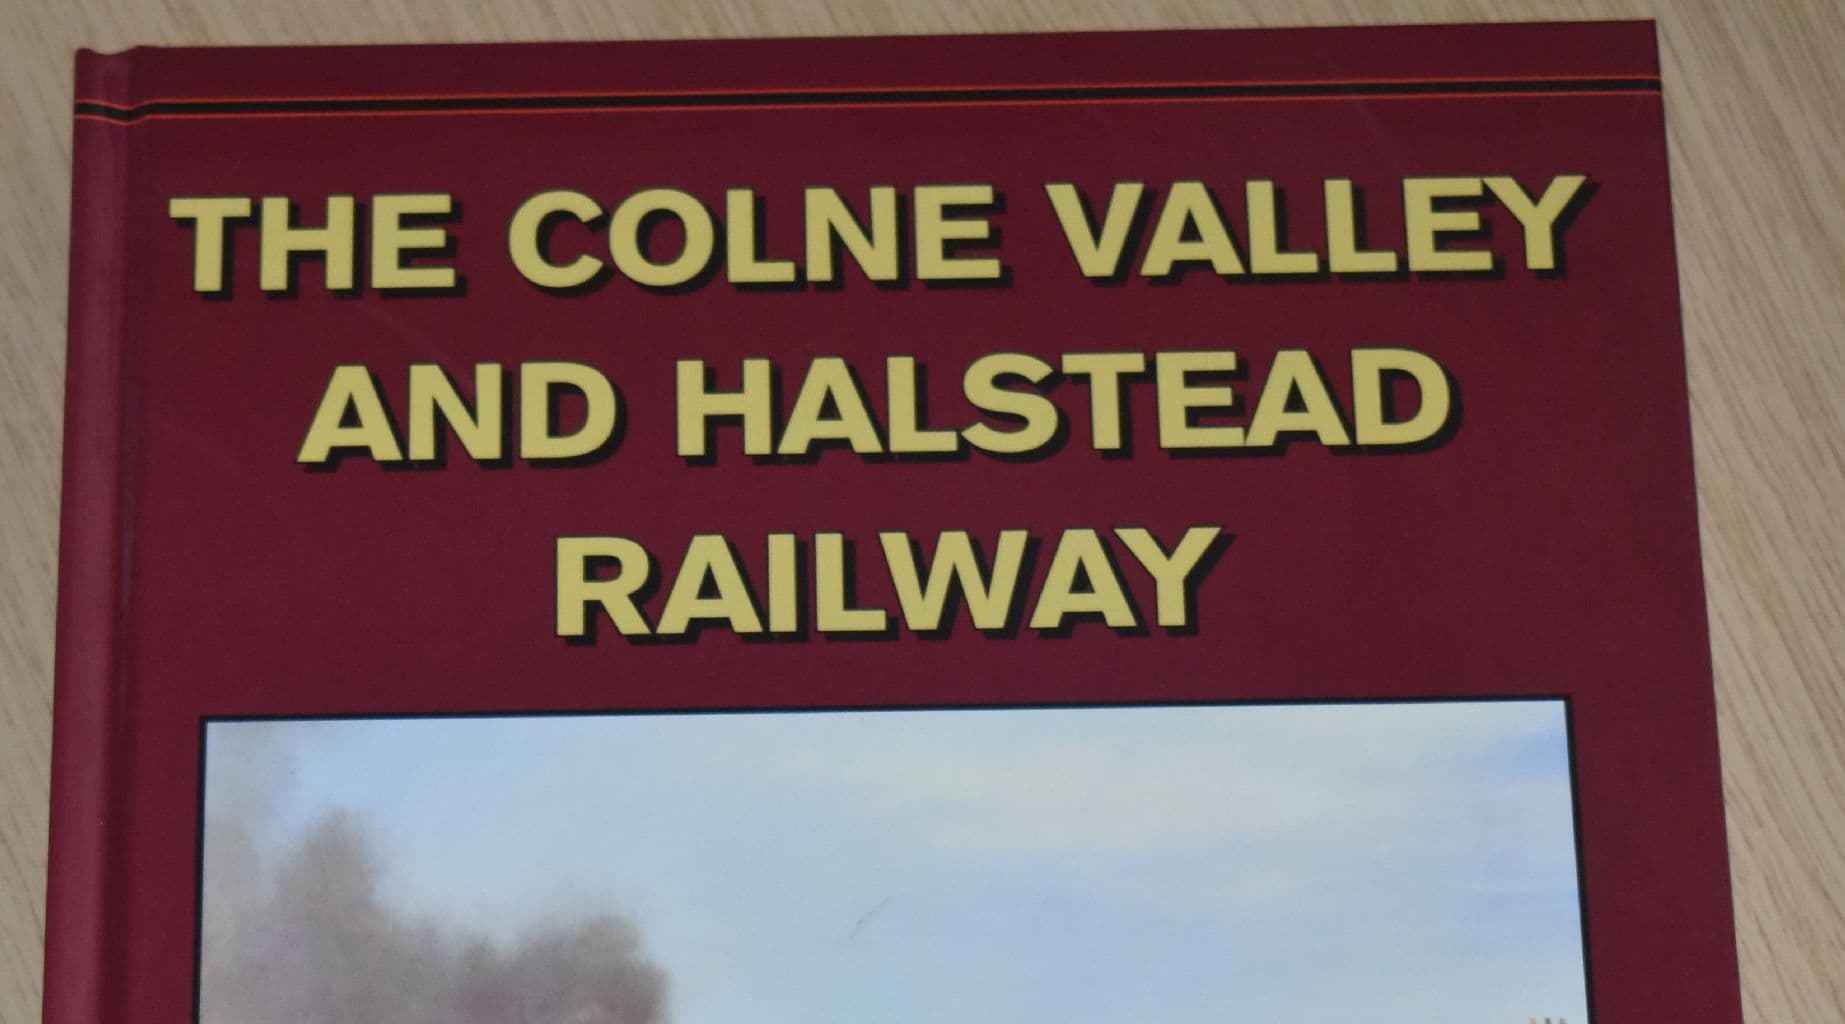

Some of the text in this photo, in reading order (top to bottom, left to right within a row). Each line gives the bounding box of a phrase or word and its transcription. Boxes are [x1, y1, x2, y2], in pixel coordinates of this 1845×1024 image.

[170, 175, 1588, 294] THE COLNE VALLEY
[298, 348, 1454, 464] AND HALSTEAD
[556, 526, 1224, 638] RAILWAY
